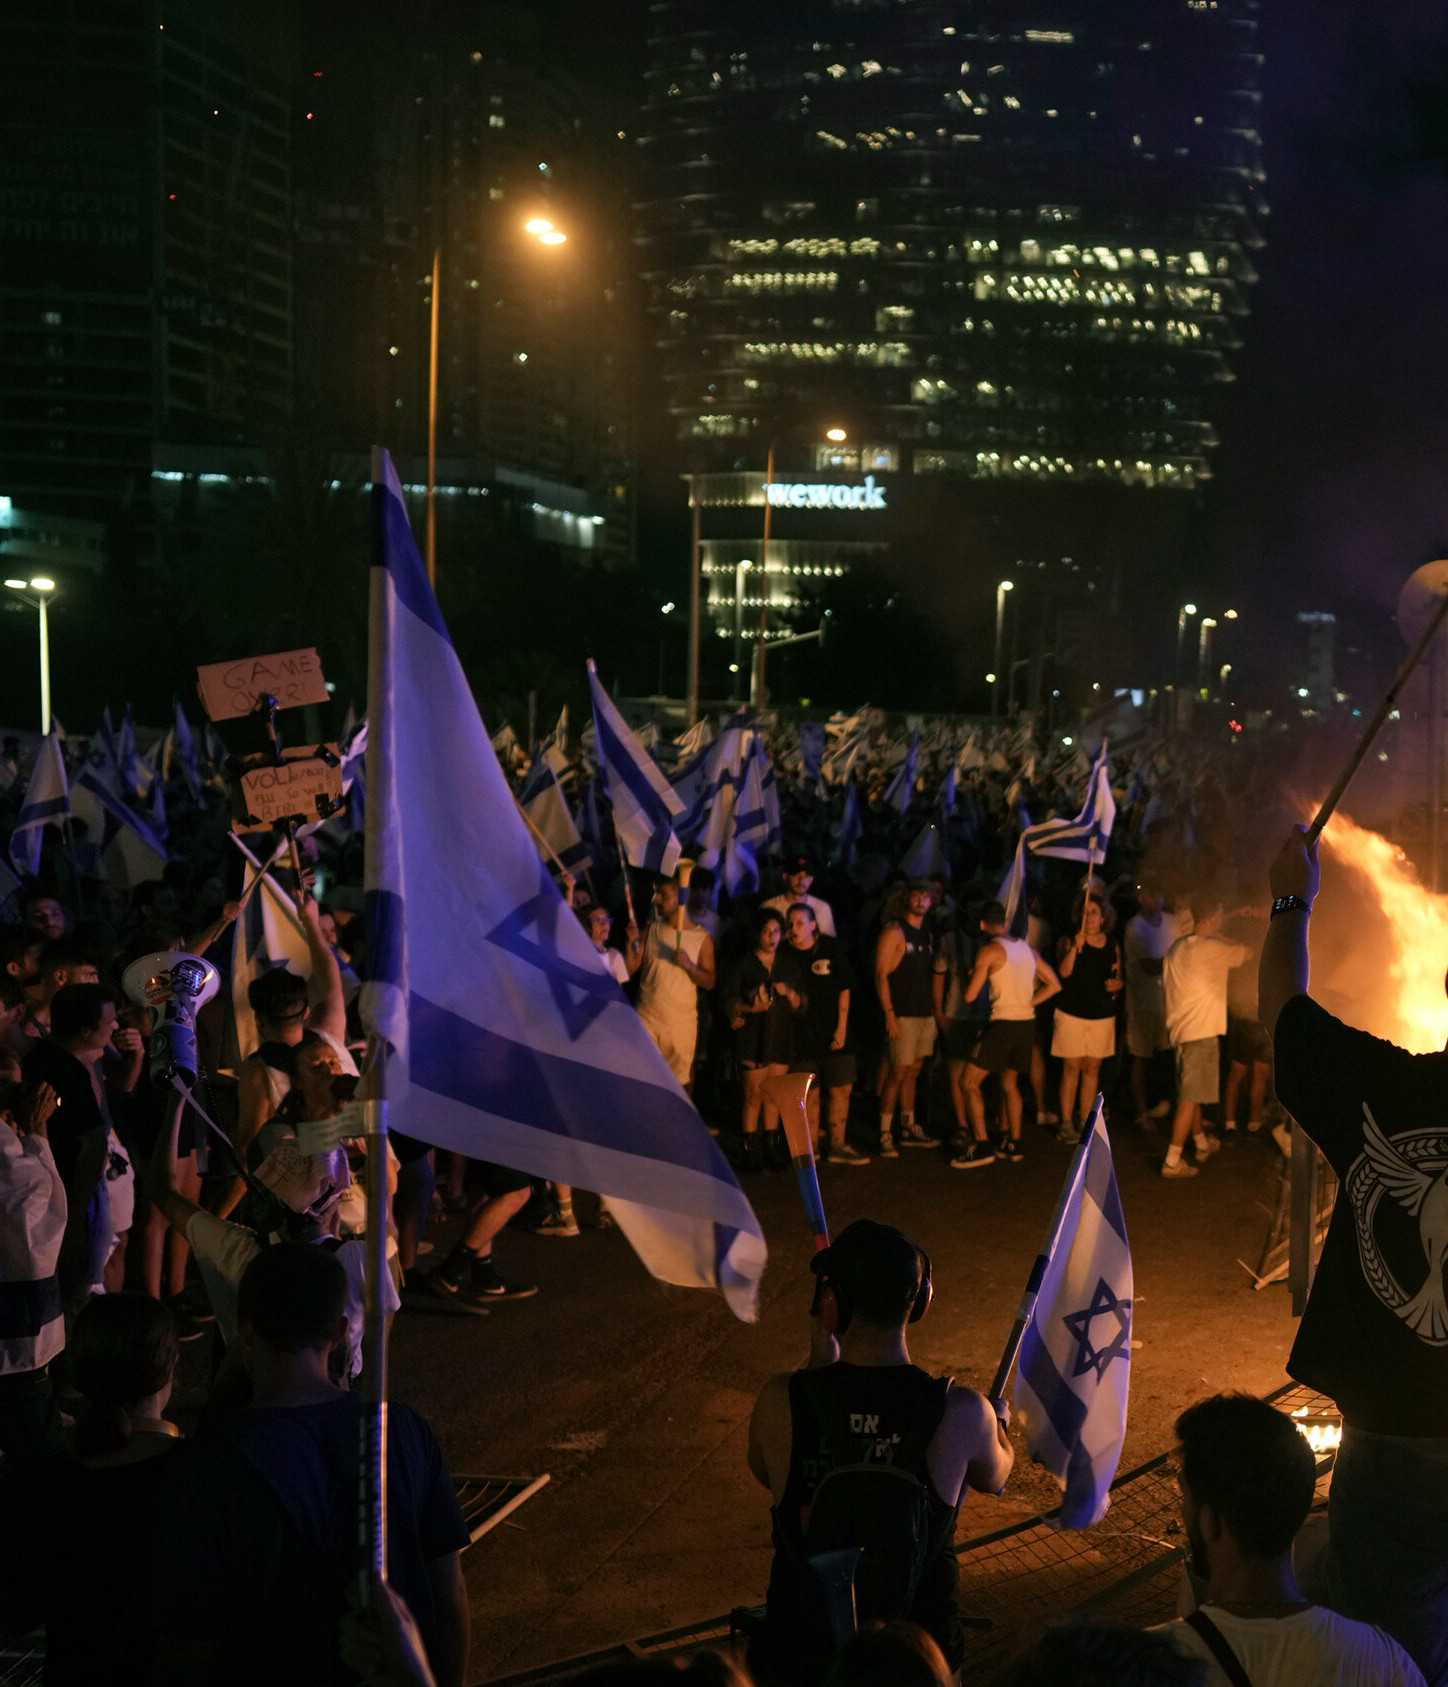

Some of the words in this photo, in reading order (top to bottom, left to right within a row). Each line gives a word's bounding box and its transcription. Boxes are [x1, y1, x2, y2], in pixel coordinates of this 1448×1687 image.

[761, 474, 888, 509] wework
[222, 655, 313, 689] GAME
[849, 1413, 881, 1434] אם
